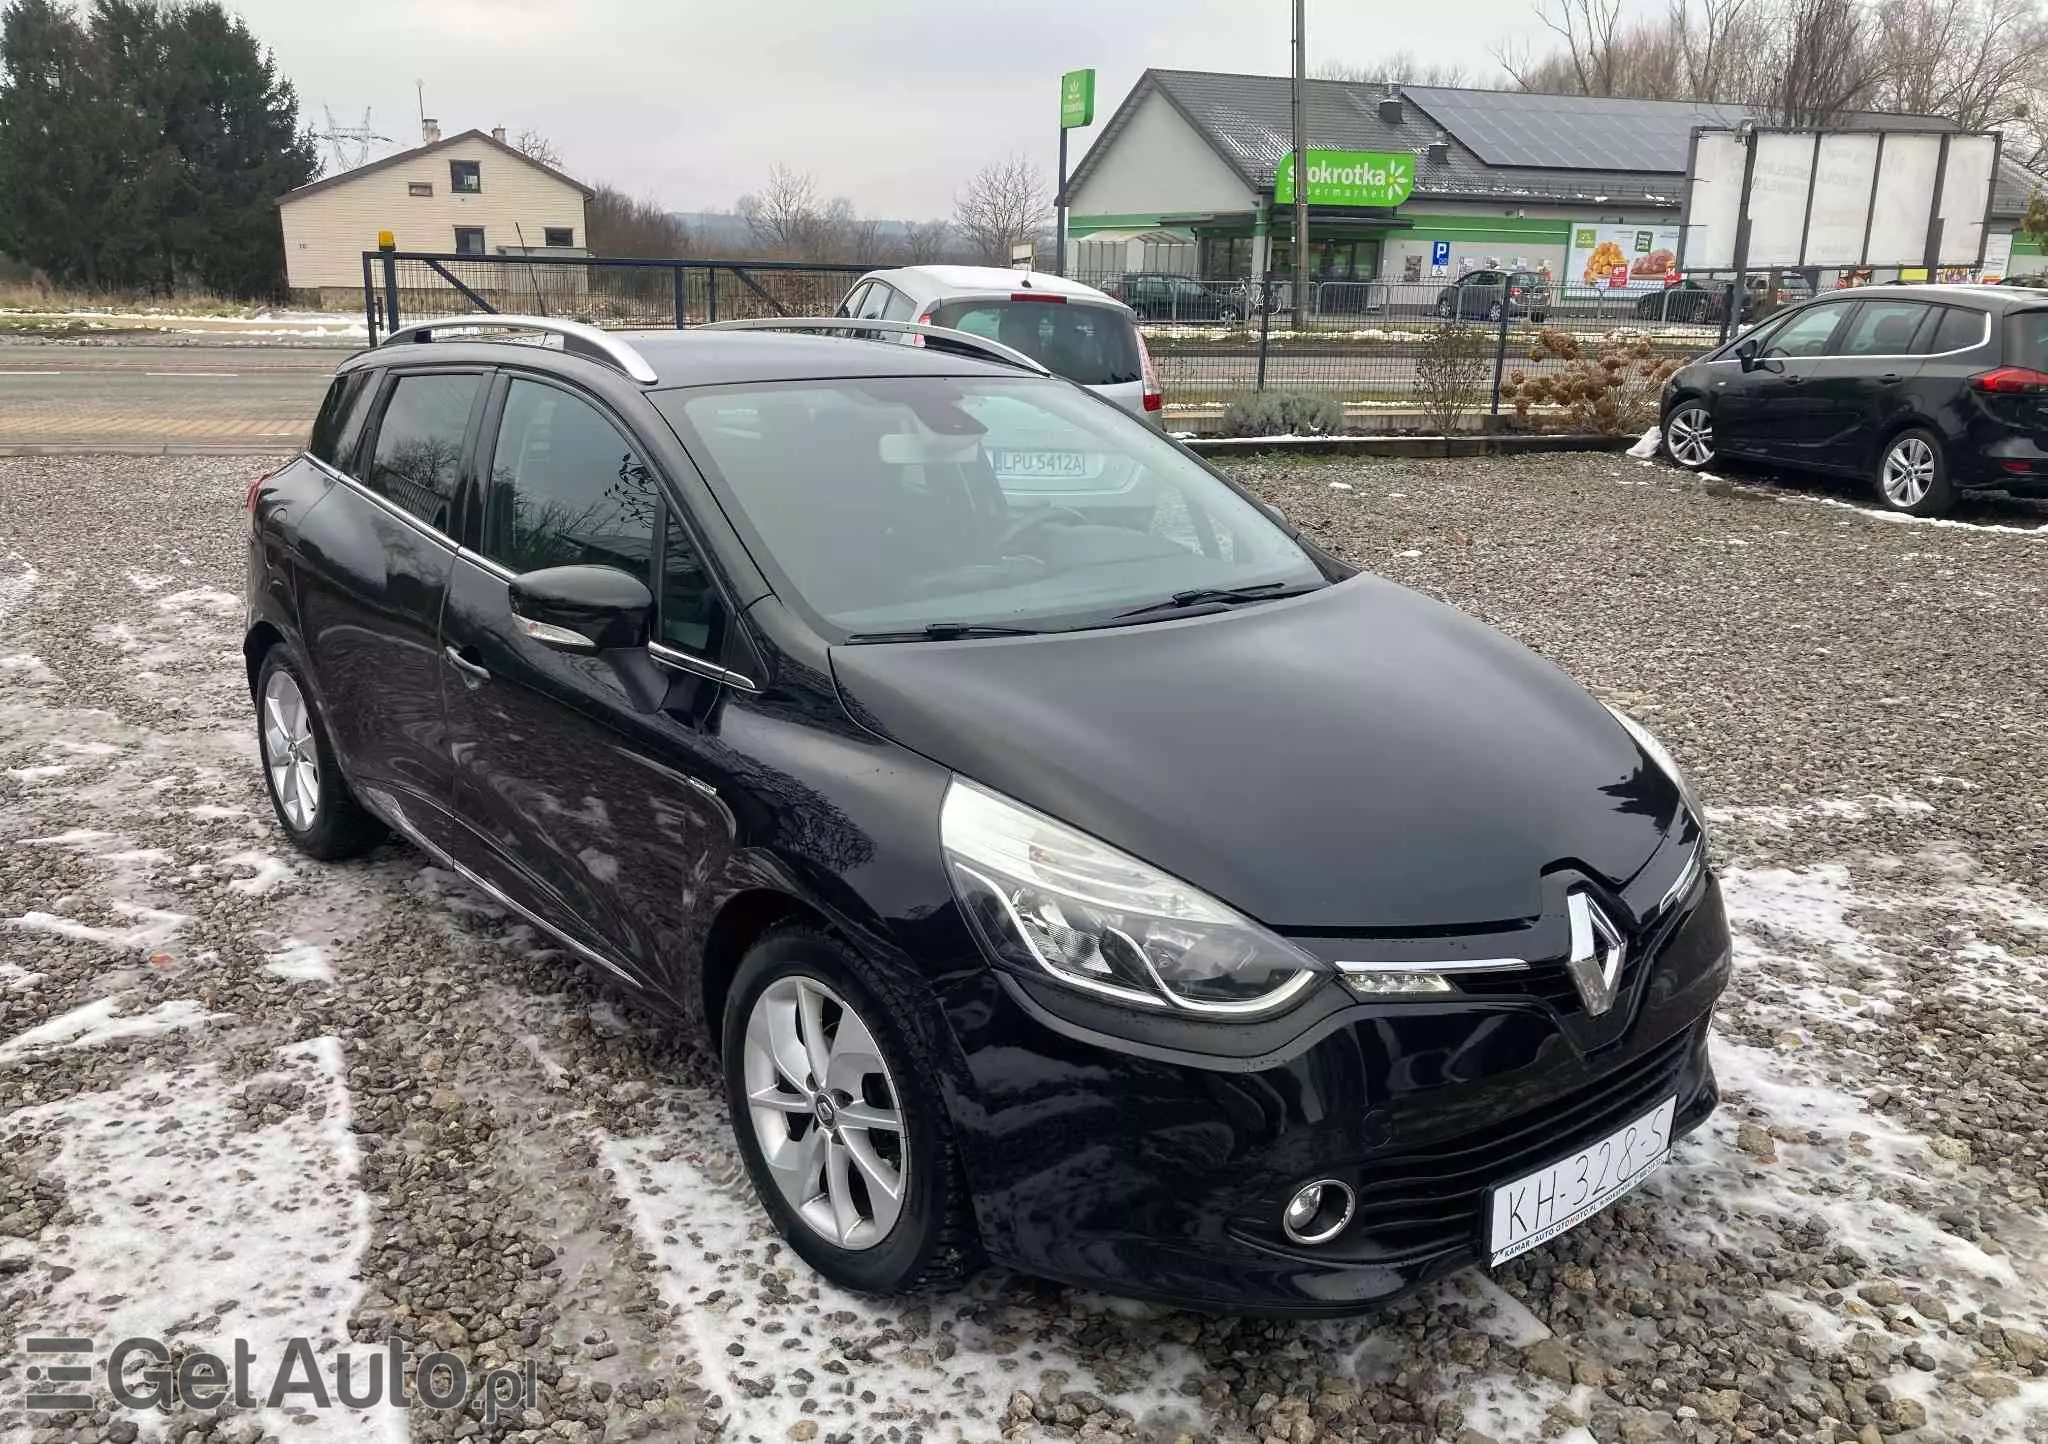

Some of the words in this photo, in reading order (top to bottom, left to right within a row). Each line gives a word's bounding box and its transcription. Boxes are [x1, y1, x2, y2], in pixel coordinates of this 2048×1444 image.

[1287, 160, 1386, 187] sokrotka
[1437, 243, 1447, 259] P
[1003, 453, 1032, 472] LPU
[1037, 453, 1083, 472] 5412A
